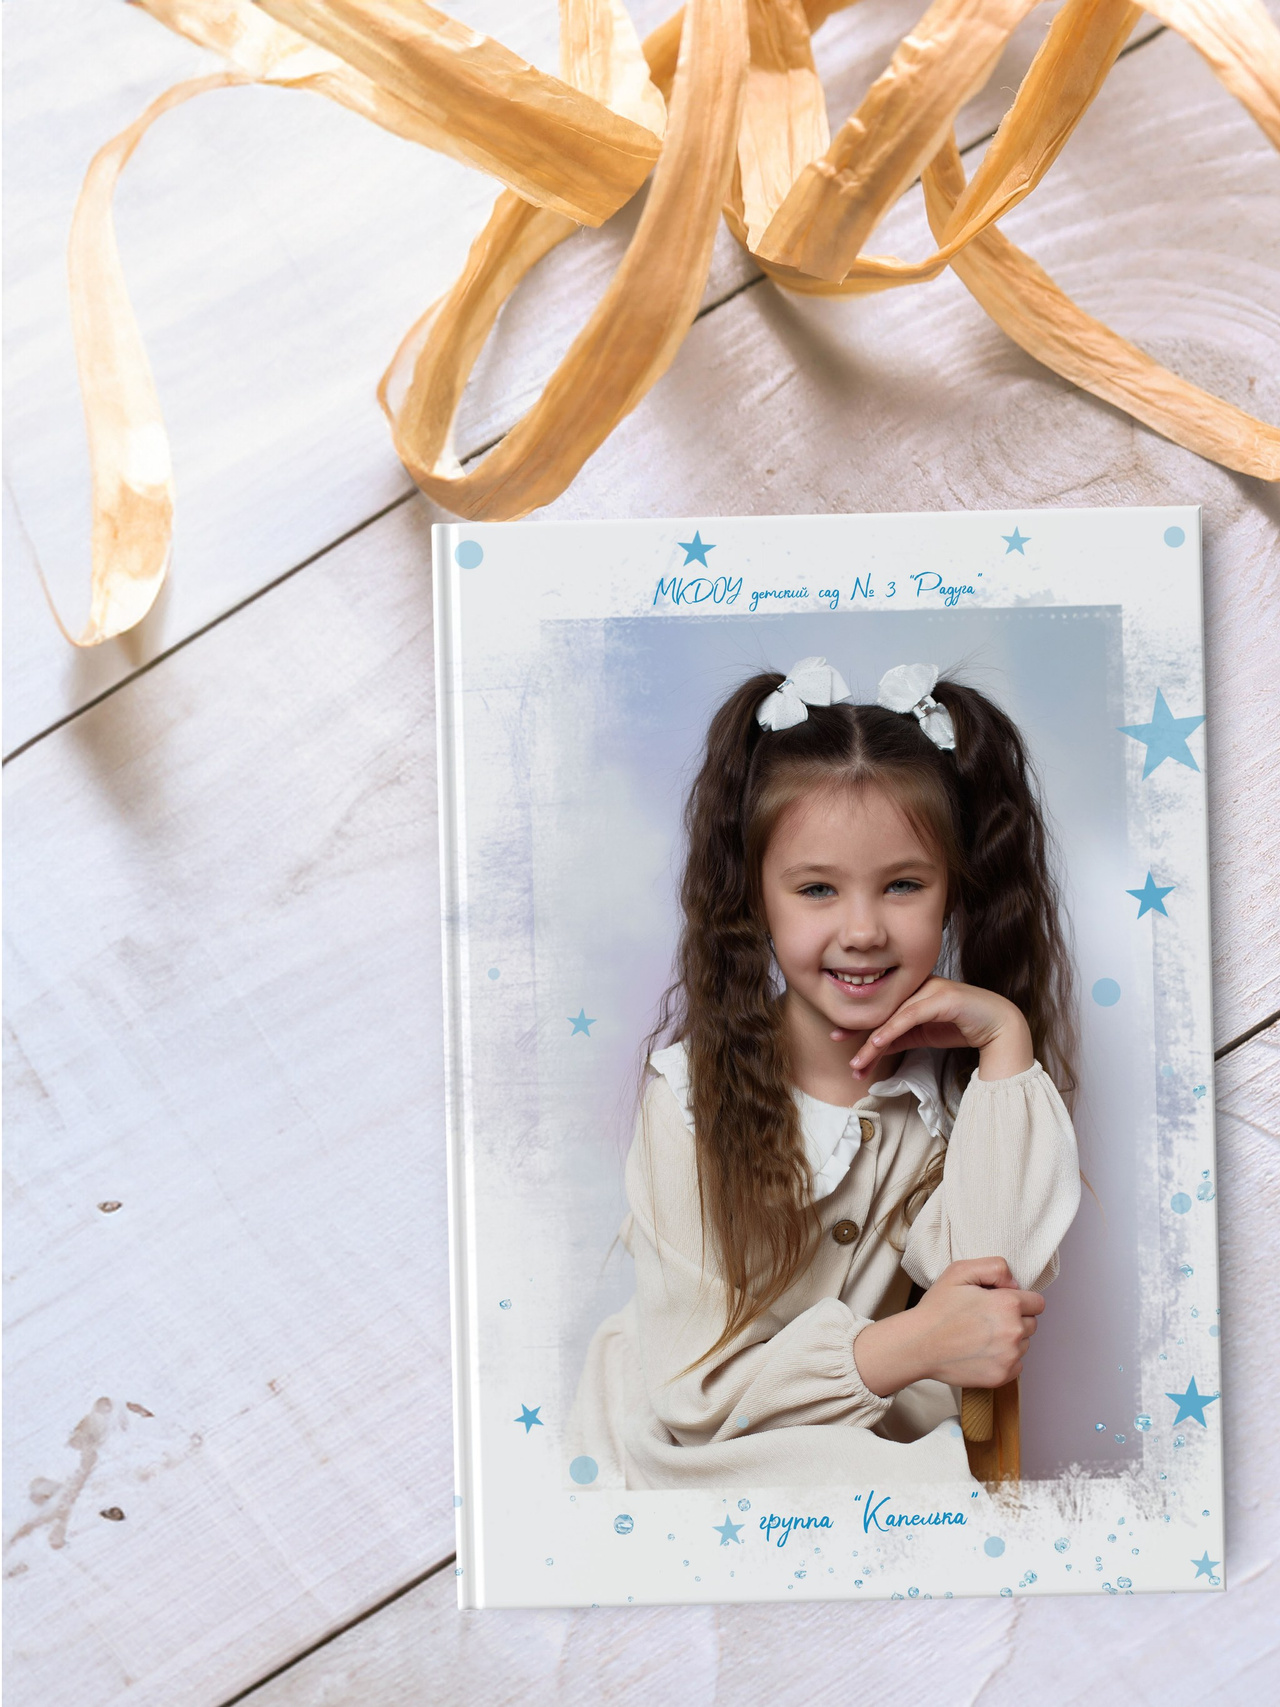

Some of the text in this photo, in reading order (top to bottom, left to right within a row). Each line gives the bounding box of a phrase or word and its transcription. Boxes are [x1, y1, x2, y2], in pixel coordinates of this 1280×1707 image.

[748, 586, 810, 612] детский
[818, 588, 841, 610] сад
[885, 581, 897, 598] 3
[759, 1513, 834, 1548] группа
